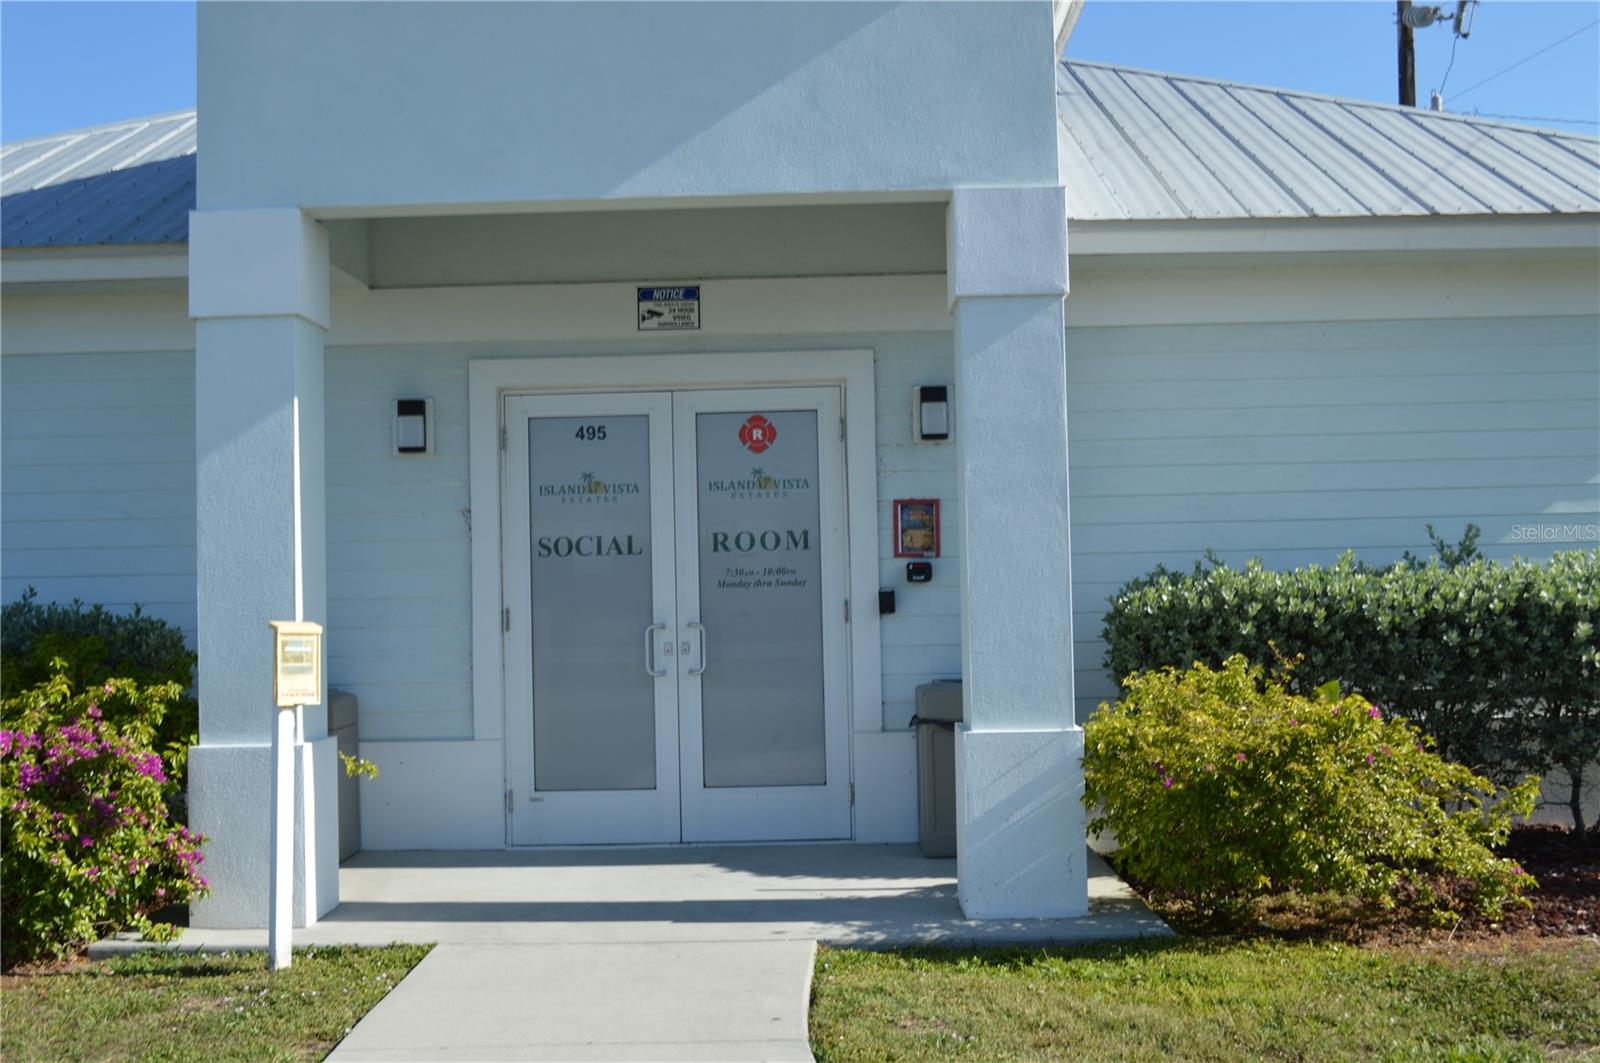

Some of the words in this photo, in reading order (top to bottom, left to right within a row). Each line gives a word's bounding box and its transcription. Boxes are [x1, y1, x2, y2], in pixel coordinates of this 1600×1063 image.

[653, 288, 684, 300] NOTICE
[575, 425, 607, 441] 495
[752, 428, 763, 441] R
[539, 484, 585, 497] ISLAND
[603, 483, 640, 494] VISTA
[708, 480, 755, 492] ISLAND
[772, 478, 810, 489] VISTA
[561, 496, 619, 504] ESTATES
[730, 491, 788, 500] ESTATES
[537, 535, 644, 558] SOCIAL
[711, 529, 810, 553] ROOM
[716, 579, 752, 590] Monday
[753, 579, 773, 588] thru
[774, 578, 807, 589] Sunday
